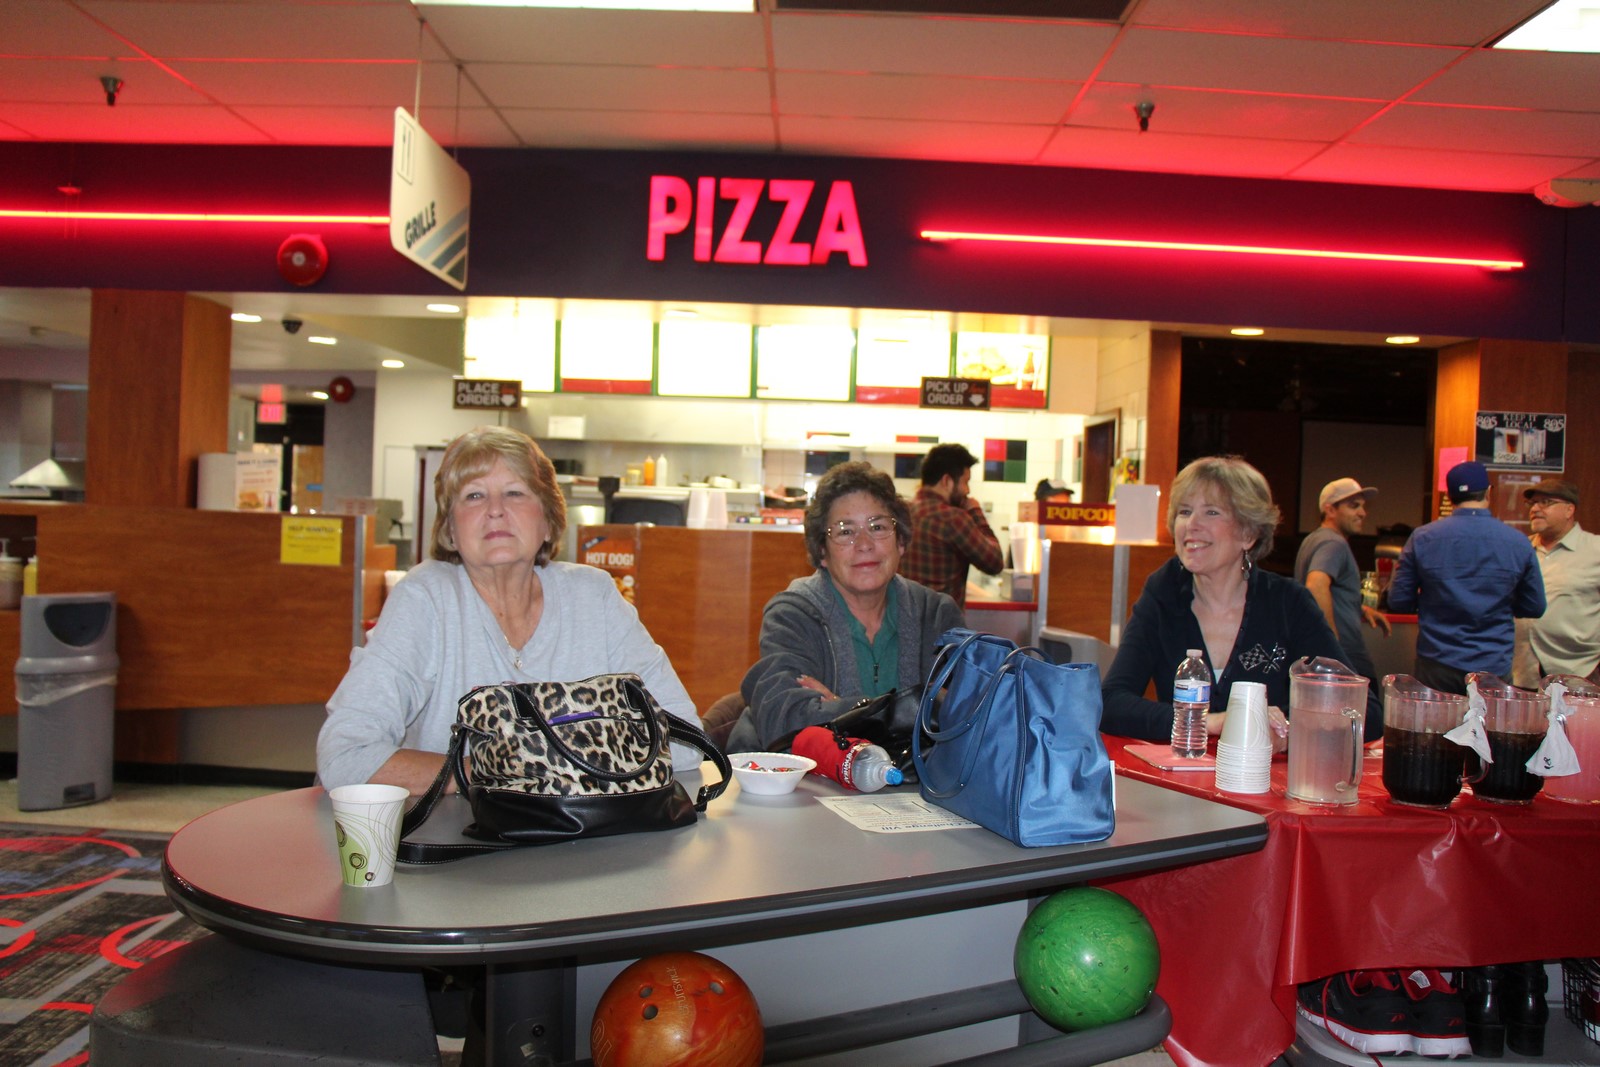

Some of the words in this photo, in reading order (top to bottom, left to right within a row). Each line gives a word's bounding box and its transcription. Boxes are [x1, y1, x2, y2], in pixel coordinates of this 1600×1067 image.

[405, 200, 436, 249] GRILLE
[647, 175, 868, 267] PIZZA
[458, 382, 500, 394] PLACE
[926, 381, 950, 393] PICK
[953, 382, 969, 393] UP
[457, 393, 500, 405] ORDER
[927, 393, 963, 404] ORDER
[1476, 415, 1498, 428] 805
[1503, 412, 1527, 421] KEEP
[1529, 414, 1538, 422] IT
[1543, 418, 1565, 431] 805
[586, 552, 606, 565] HOT
[608, 553, 634, 566] DOG!
